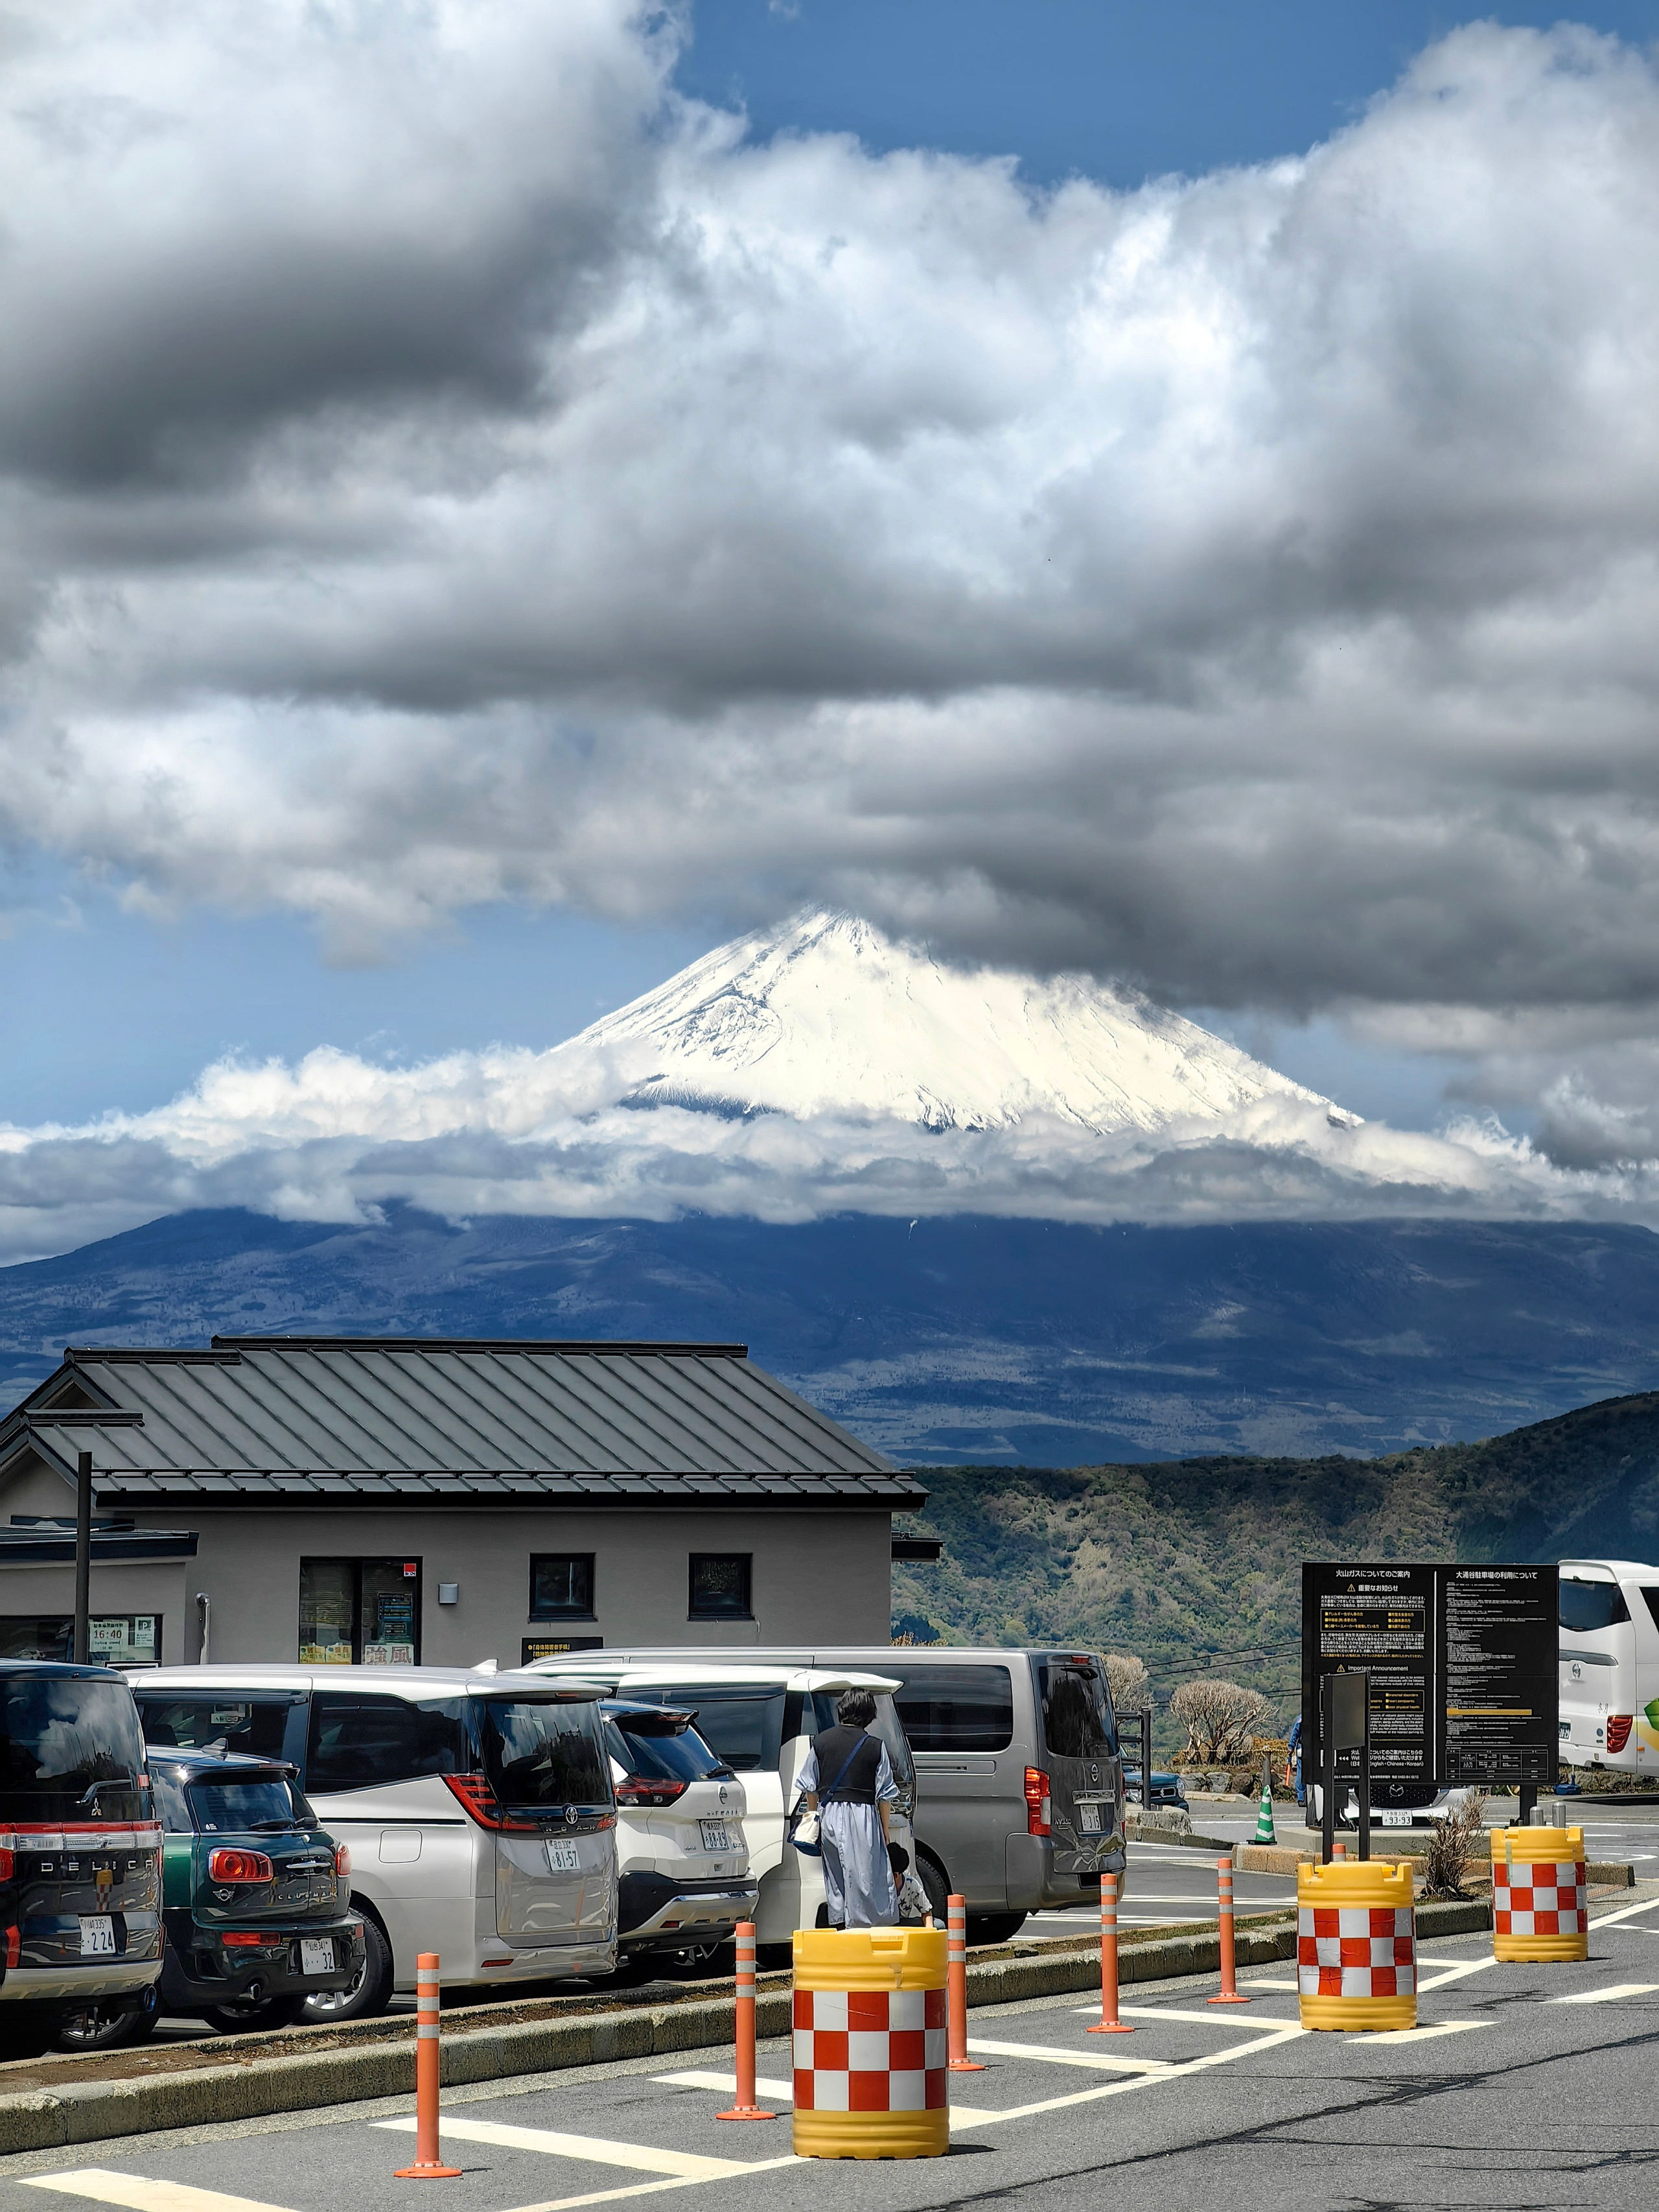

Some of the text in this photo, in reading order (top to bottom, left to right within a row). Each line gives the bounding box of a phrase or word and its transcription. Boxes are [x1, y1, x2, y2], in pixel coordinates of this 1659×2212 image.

[1336, 1570, 1410, 1578] 火山ガスについてのご案内
[1456, 1571, 1538, 1579] 大涌谷駐車場の利用について
[94, 1630, 122, 1638] 16:40
[366, 1646, 412, 1665] 強風
[556, 1850, 577, 1867] 81-57
[41, 1859, 154, 1872] DELICA
